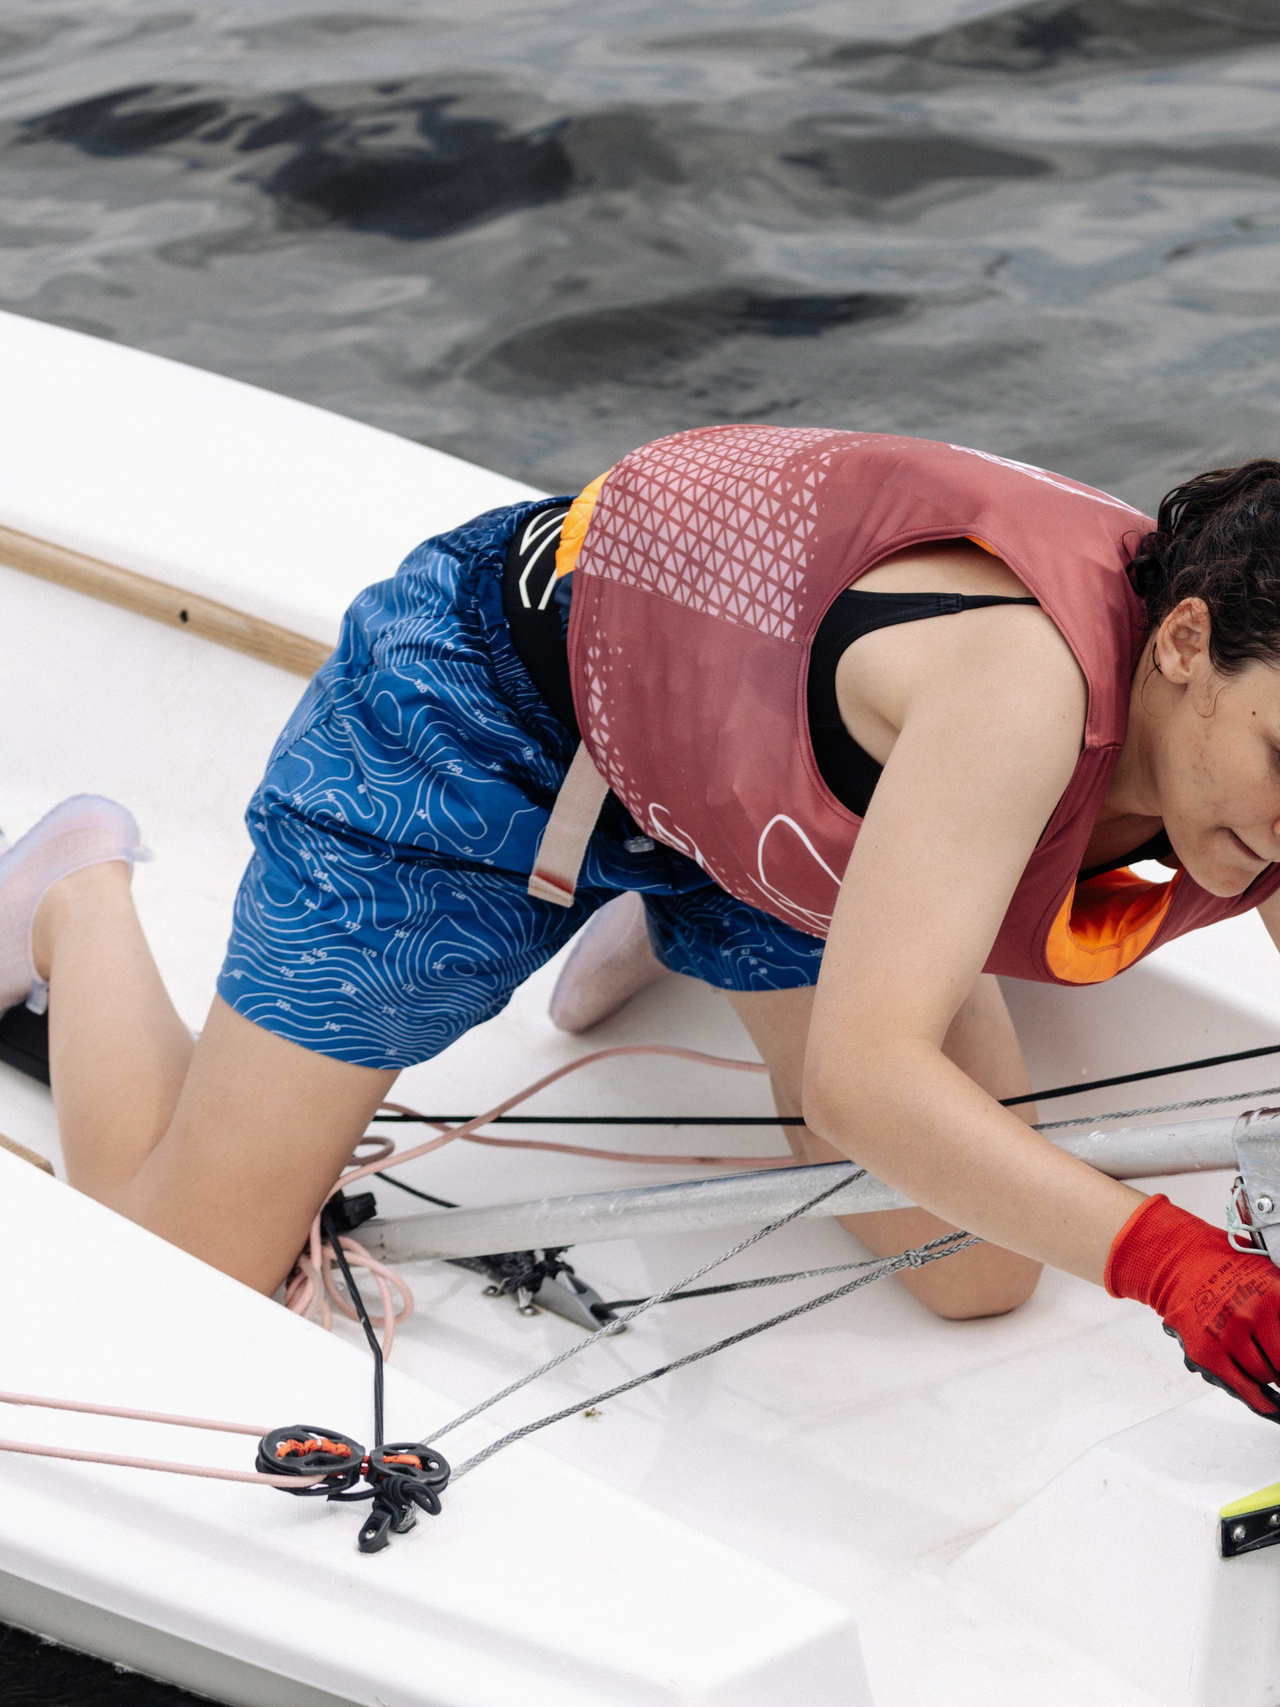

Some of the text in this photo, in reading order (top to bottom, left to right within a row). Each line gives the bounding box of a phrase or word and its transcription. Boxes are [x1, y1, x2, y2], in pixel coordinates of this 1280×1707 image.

[473, 709, 488, 724] 210
[446, 761, 463, 774] 220
[275, 999, 292, 1012] 220
